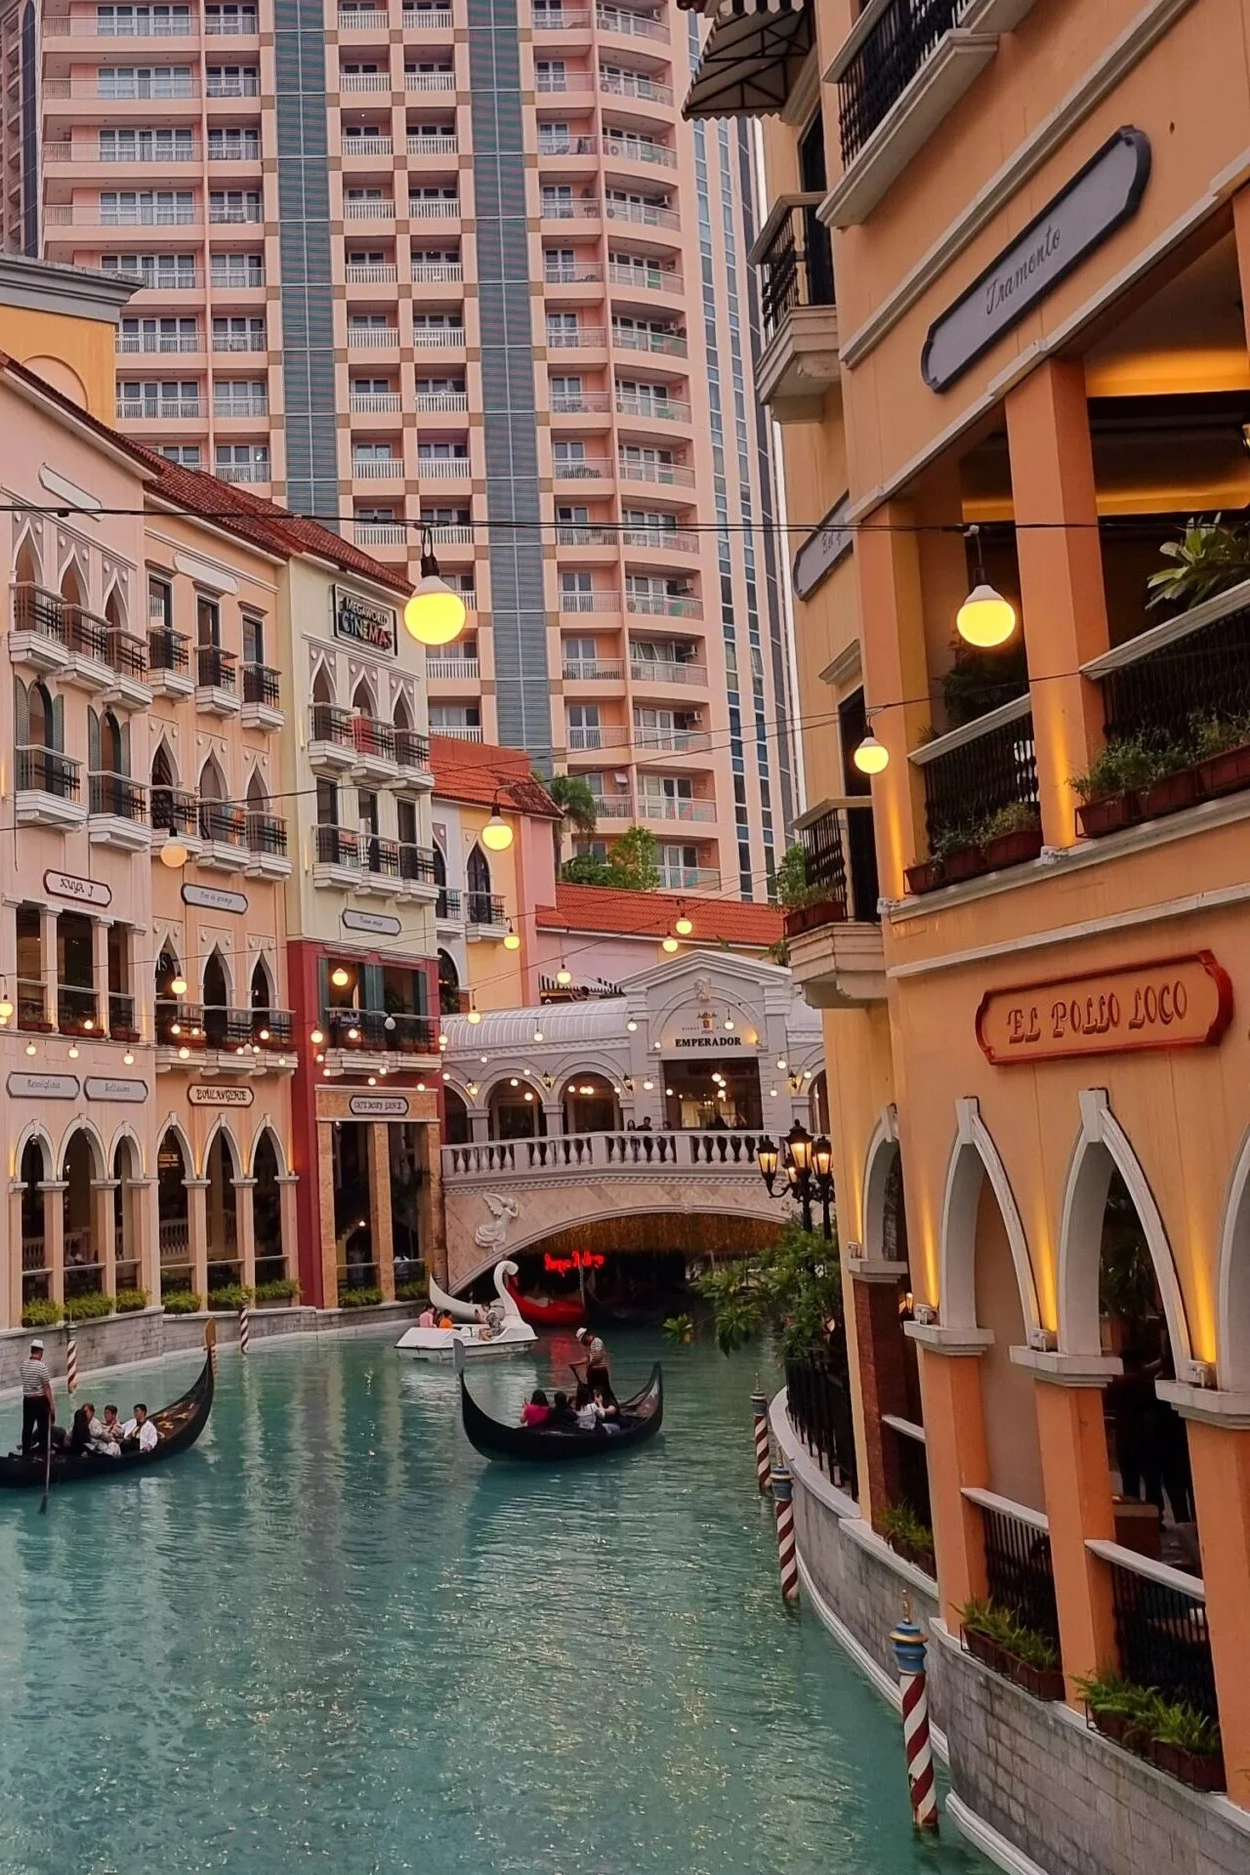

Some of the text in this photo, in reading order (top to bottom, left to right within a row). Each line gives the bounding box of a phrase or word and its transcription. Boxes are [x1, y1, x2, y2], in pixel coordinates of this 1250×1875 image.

[986, 225, 1061, 315] Tramonto
[675, 1037, 742, 1048] EMPERADOR
[1007, 980, 1187, 1044] EL POLLO LOCO
